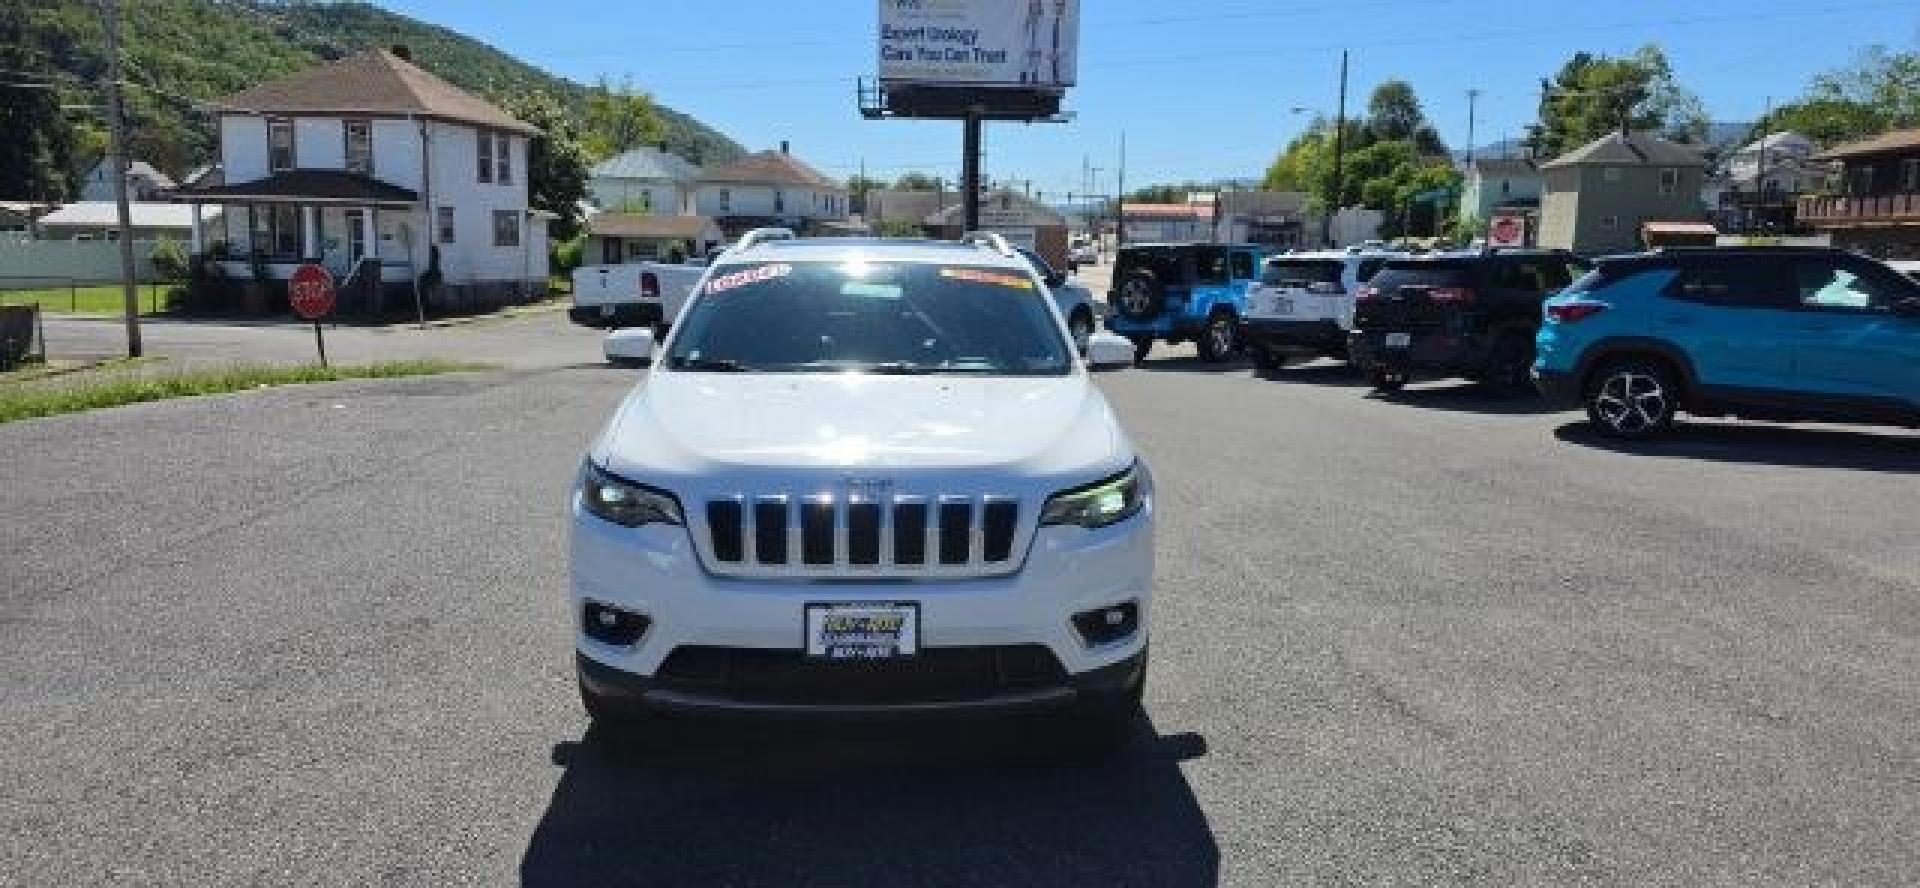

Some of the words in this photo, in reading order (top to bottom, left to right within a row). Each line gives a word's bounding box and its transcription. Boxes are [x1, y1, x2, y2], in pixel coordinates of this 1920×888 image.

[881, 24, 925, 42] Expert
[927, 25, 979, 46] Urology
[881, 45, 913, 61] Care
[915, 46, 942, 61] You
[944, 48, 971, 62] Can
[972, 47, 1008, 63] Trust
[293, 281, 330, 300] STOP
